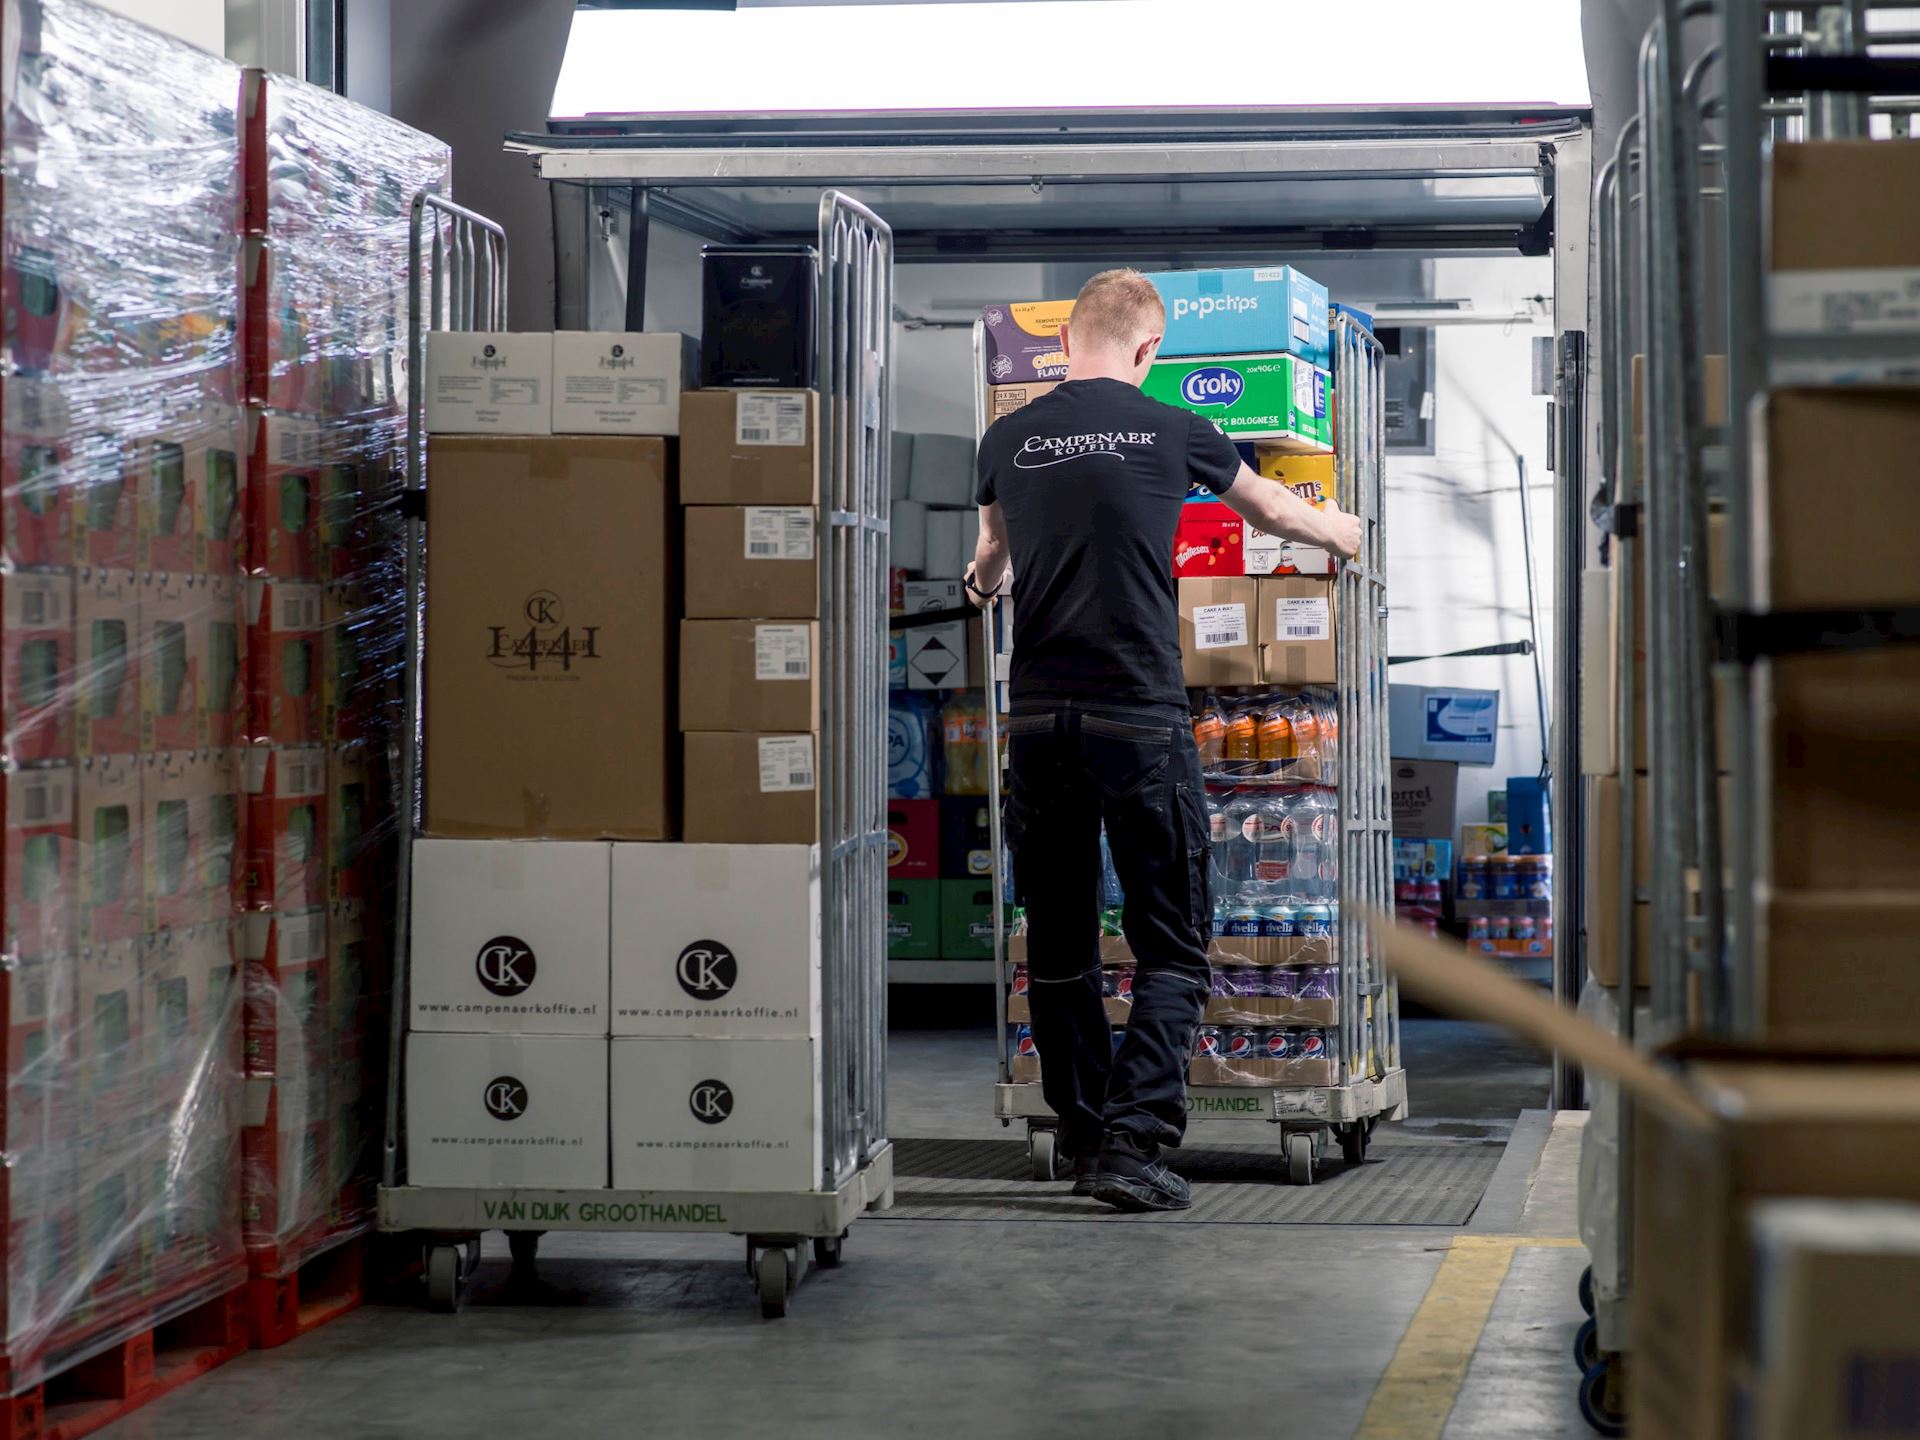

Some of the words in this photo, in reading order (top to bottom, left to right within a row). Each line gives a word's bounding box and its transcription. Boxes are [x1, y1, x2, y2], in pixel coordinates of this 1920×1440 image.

[1174, 294, 1258, 320] popchips
[1186, 372, 1241, 401] Croky
[1230, 416, 1279, 426] BOLOGNESE
[1024, 432, 1154, 452] CAMPENAER
[1054, 442, 1117, 456] KOFFIE
[1176, 546, 1210, 568] Maltesers
[526, 597, 557, 624] CK
[1232, 923, 1258, 933] rivella
[1266, 922, 1294, 932] rivella
[478, 945, 528, 987] CK
[679, 948, 730, 990] CK
[418, 1003, 596, 1015] www.campenaerkoffie.nl
[618, 1006, 798, 1019] www.campenaerkoffie.nl
[486, 1083, 523, 1114] CK
[691, 1086, 728, 1117] CK
[432, 1136, 583, 1146] www.campenaerkoffie.nl
[636, 1140, 789, 1150] www.campenaerkoffie.nl
[484, 1201, 525, 1220] VAN
[531, 1202, 570, 1220] DIJK
[578, 1203, 728, 1222] GROOTHANDEL
